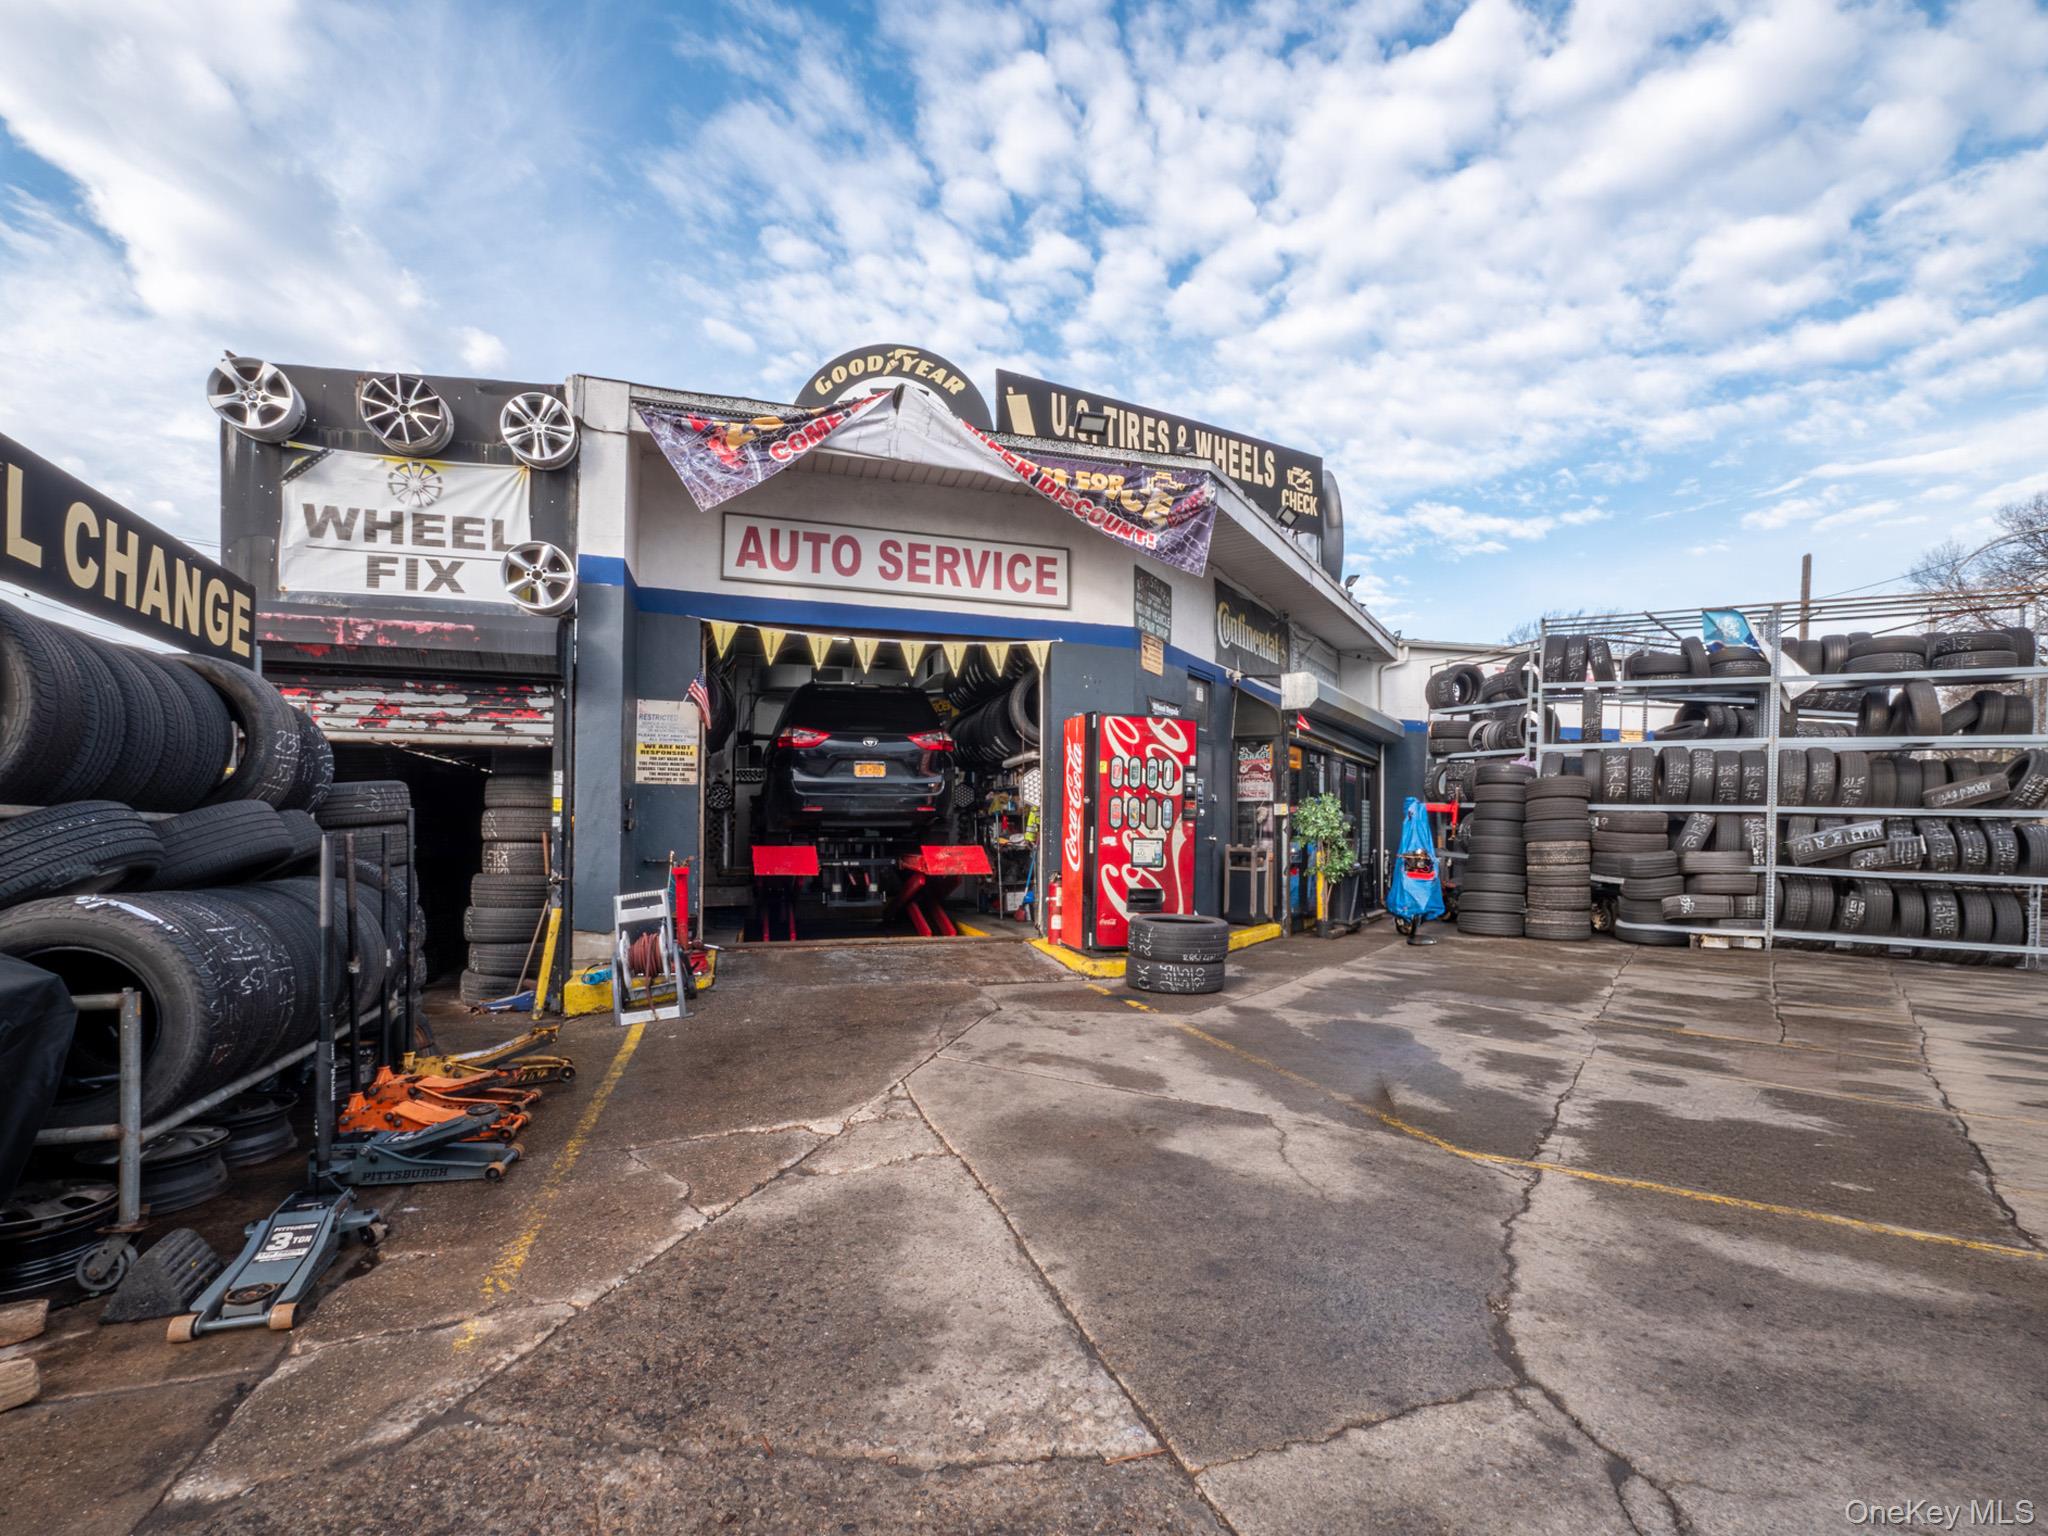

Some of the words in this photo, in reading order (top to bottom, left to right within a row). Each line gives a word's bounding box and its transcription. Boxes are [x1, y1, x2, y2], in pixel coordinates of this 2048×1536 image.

[815, 352, 966, 396] GOODYEAR
[1103, 405, 1170, 454] TIRES
[1195, 429, 1276, 489] WHEELS
[302, 503, 517, 552] WHEEL
[1035, 473, 1158, 550] DISCOUNT!
[1281, 489, 1318, 517] CHECK
[64, 502, 251, 659] CHANGE
[366, 555, 466, 594] FIX
[735, 525, 861, 578] AUTO
[878, 539, 1058, 596] SERVICE
[1217, 601, 1280, 665] Continental
[1063, 736, 1083, 872] Coca-Cola
[362, 1167, 448, 1182] PITTSBURGH
[265, 1231, 294, 1251] 3
[292, 1234, 313, 1244] TON
